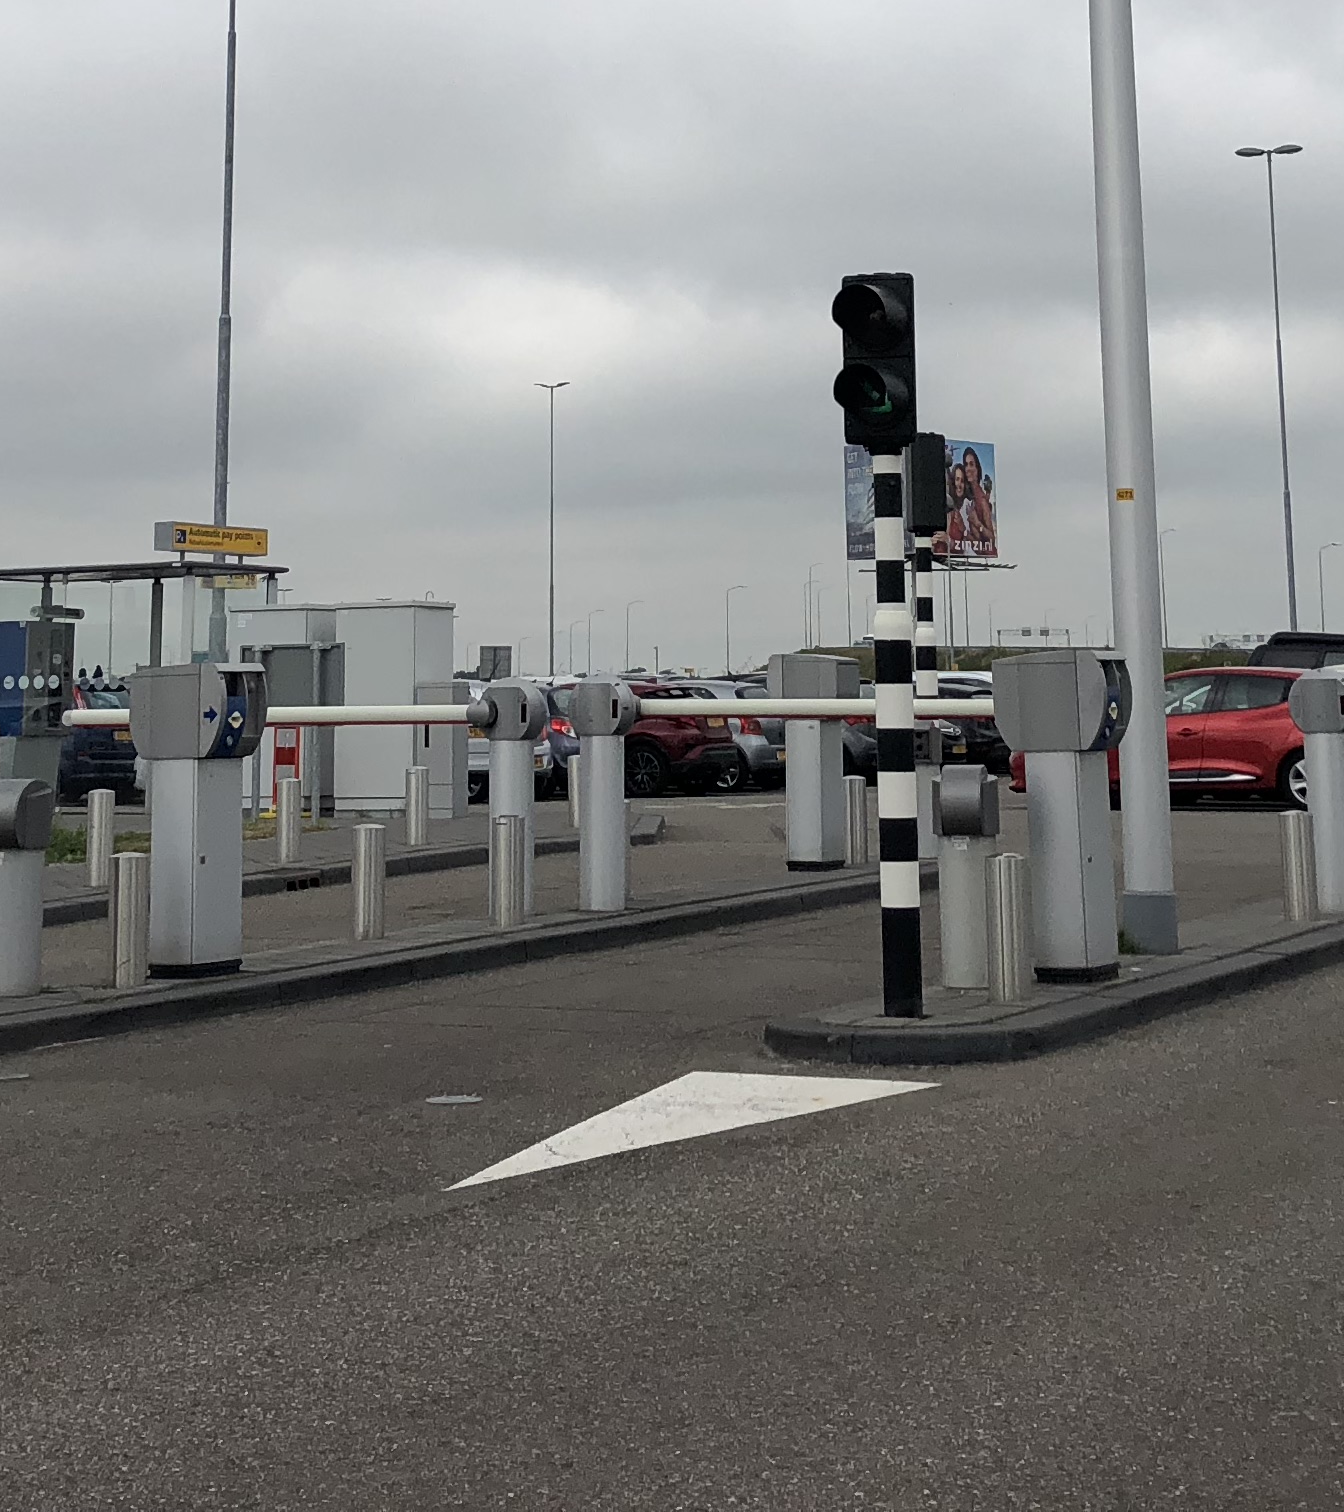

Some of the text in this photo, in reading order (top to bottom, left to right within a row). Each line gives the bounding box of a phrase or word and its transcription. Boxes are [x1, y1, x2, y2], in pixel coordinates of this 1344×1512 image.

[189, 527, 220, 538] Automatic
[222, 531, 233, 541] pay
[235, 531, 253, 541] points
